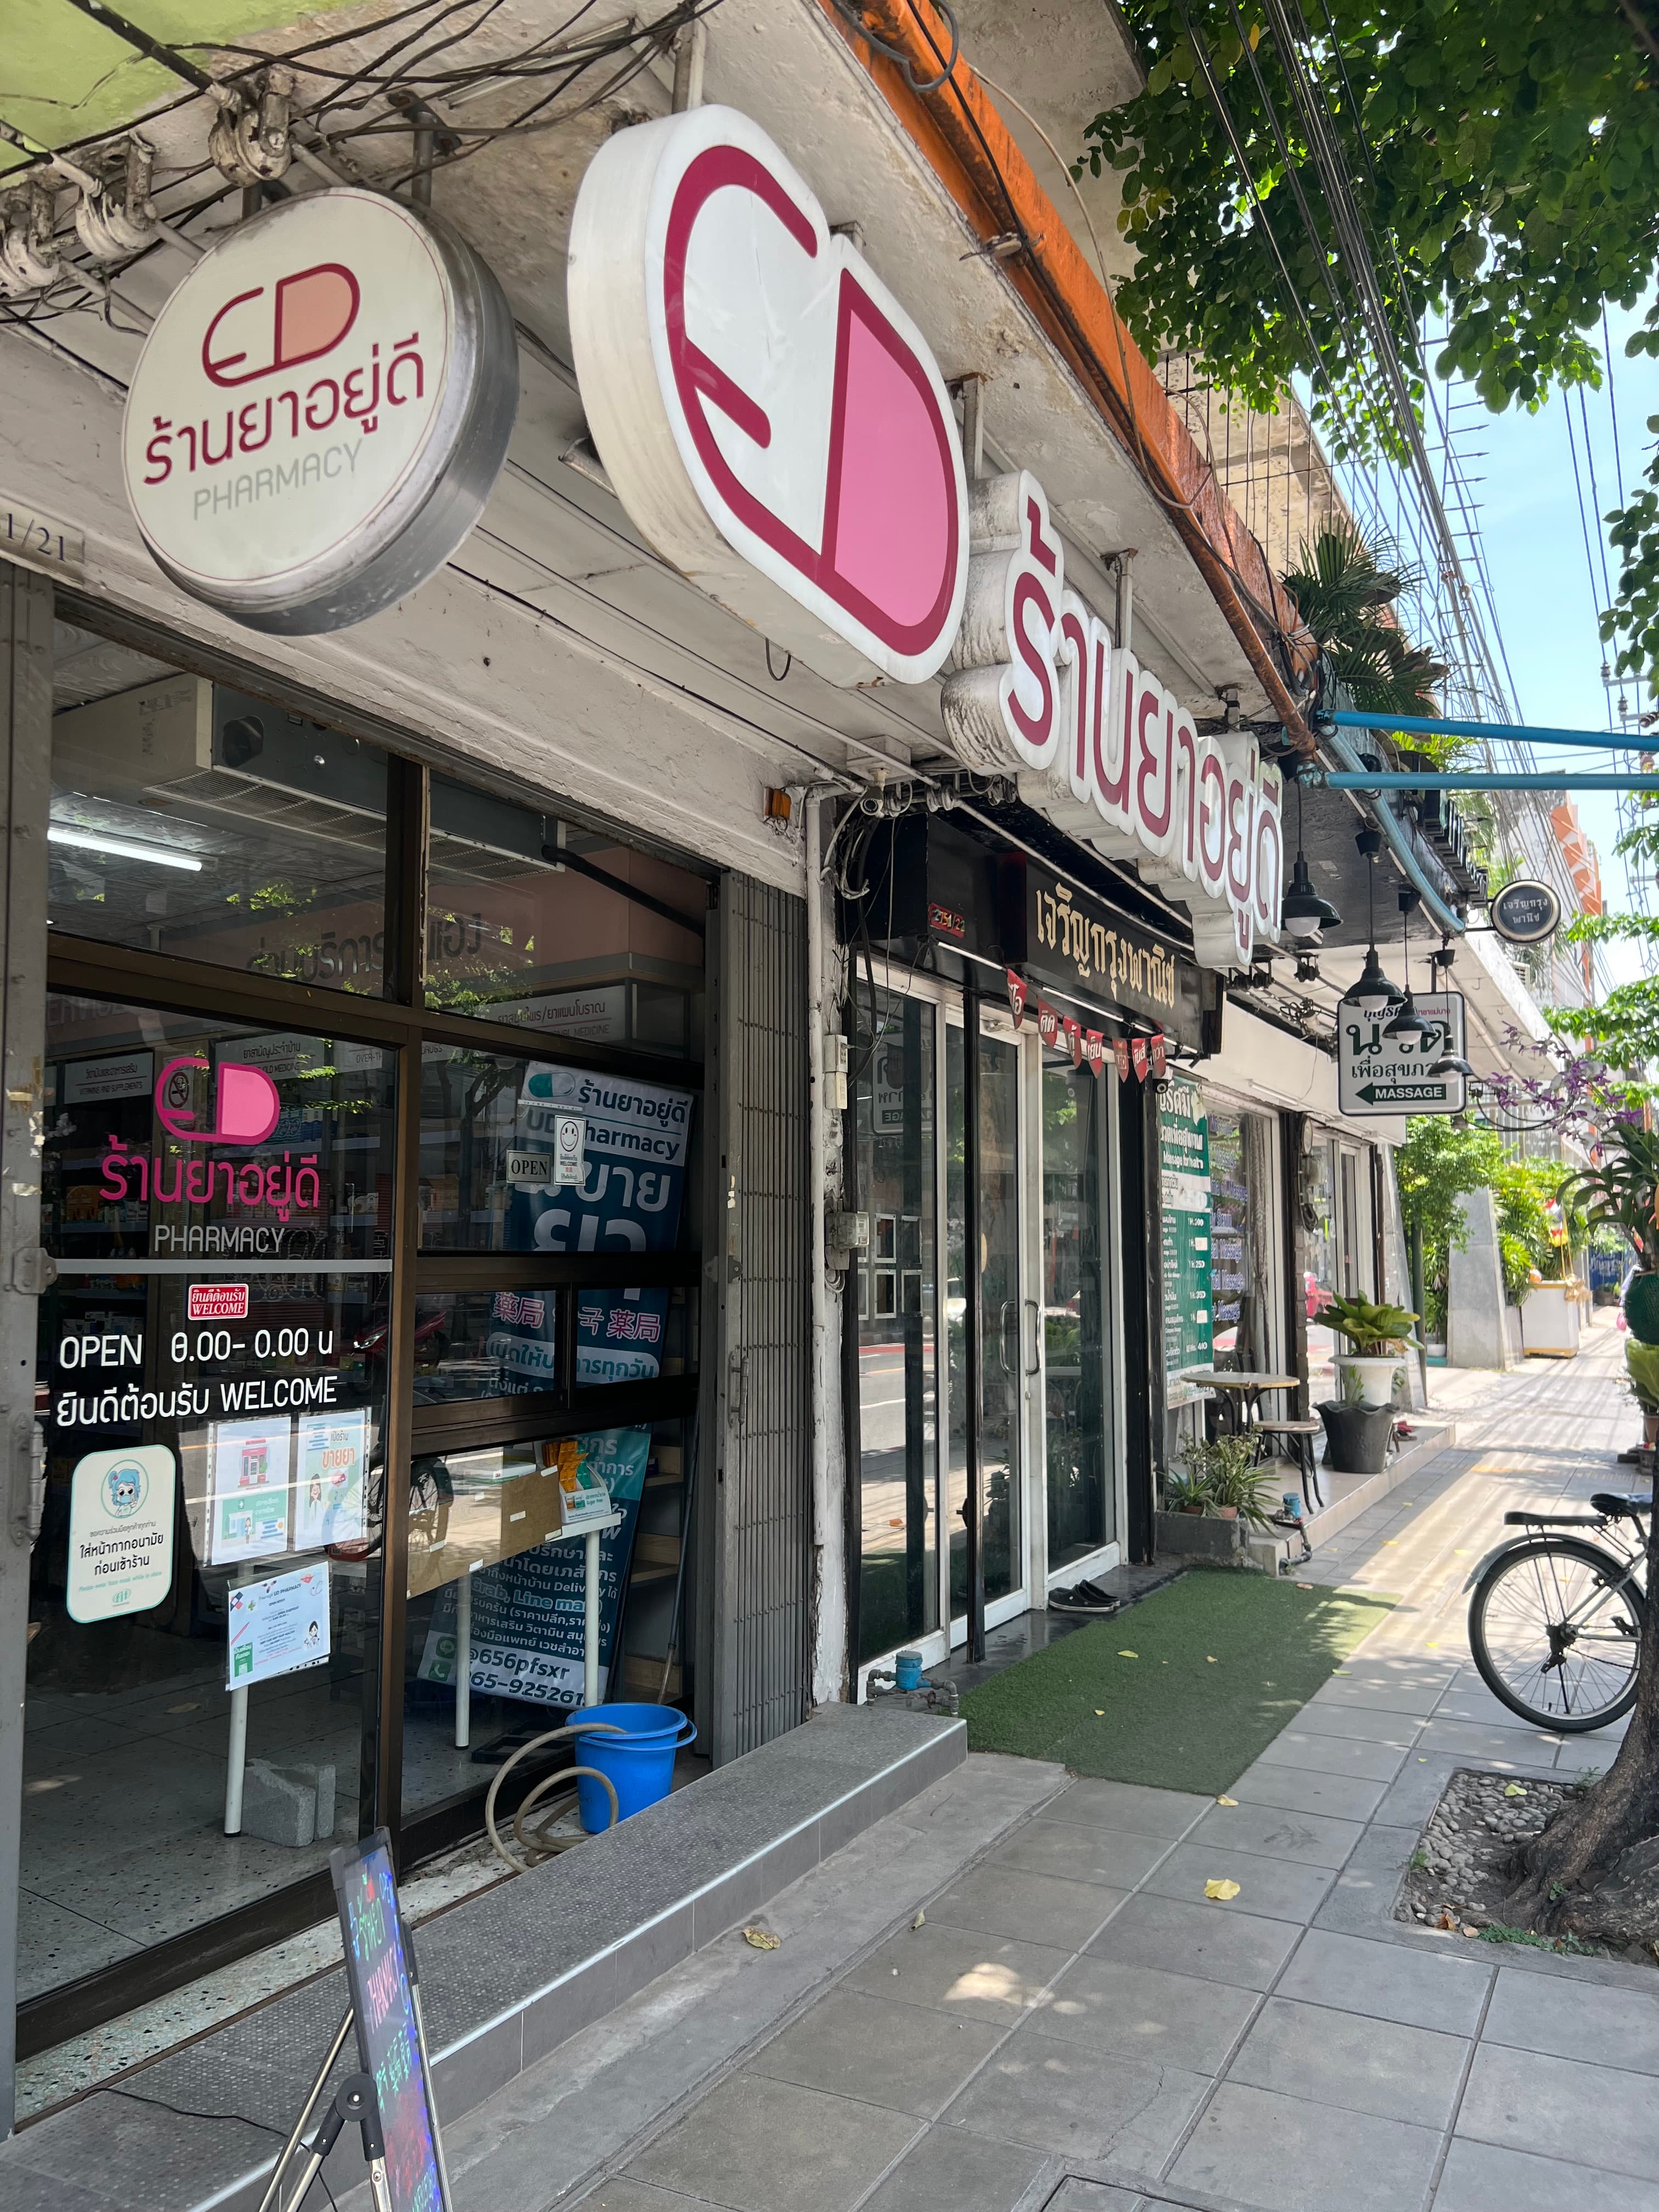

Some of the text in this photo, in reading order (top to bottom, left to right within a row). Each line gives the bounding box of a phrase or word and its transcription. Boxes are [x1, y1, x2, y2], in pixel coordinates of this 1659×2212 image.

[143, 332, 425, 486] ร้านยาอยู่ดี
[193, 438, 364, 522] PHARMACY
[1007, 495, 1280, 951] ร้านยาอยู่ดี
[1036, 882, 1175, 1009] เจริญกรุงพาณิช
[578, 1079, 689, 1127] ร้านยาอยู่ดี
[1375, 1086, 1442, 1099] MASSAGE
[585, 1120, 680, 1160] harmacy
[99, 1135, 320, 1222] ร้านยาอยู่ดี
[511, 1158, 548, 1176] OPEN
[155, 1224, 286, 1253] PHARMACY
[192, 1288, 245, 1302] ยินดีต้อนรับ
[192, 1302, 245, 1315] WELCOME
[60, 1334, 143, 1369] OPEN
[57, 1375, 338, 1426] ยินดีต้อนรับ WELCOME
[322, 1447, 356, 1468] ขายยา
[80, 1532, 164, 1559] ใส่หน้ากากอนามัย
[94, 1554, 150, 1576] ก่อนเข้าร้าน
[513, 1589, 553, 1609] Line
[554, 1582, 606, 1597] Delivy
[526, 1626, 564, 1639] วิตามิน
[470, 1671, 585, 1707] 65-925261
